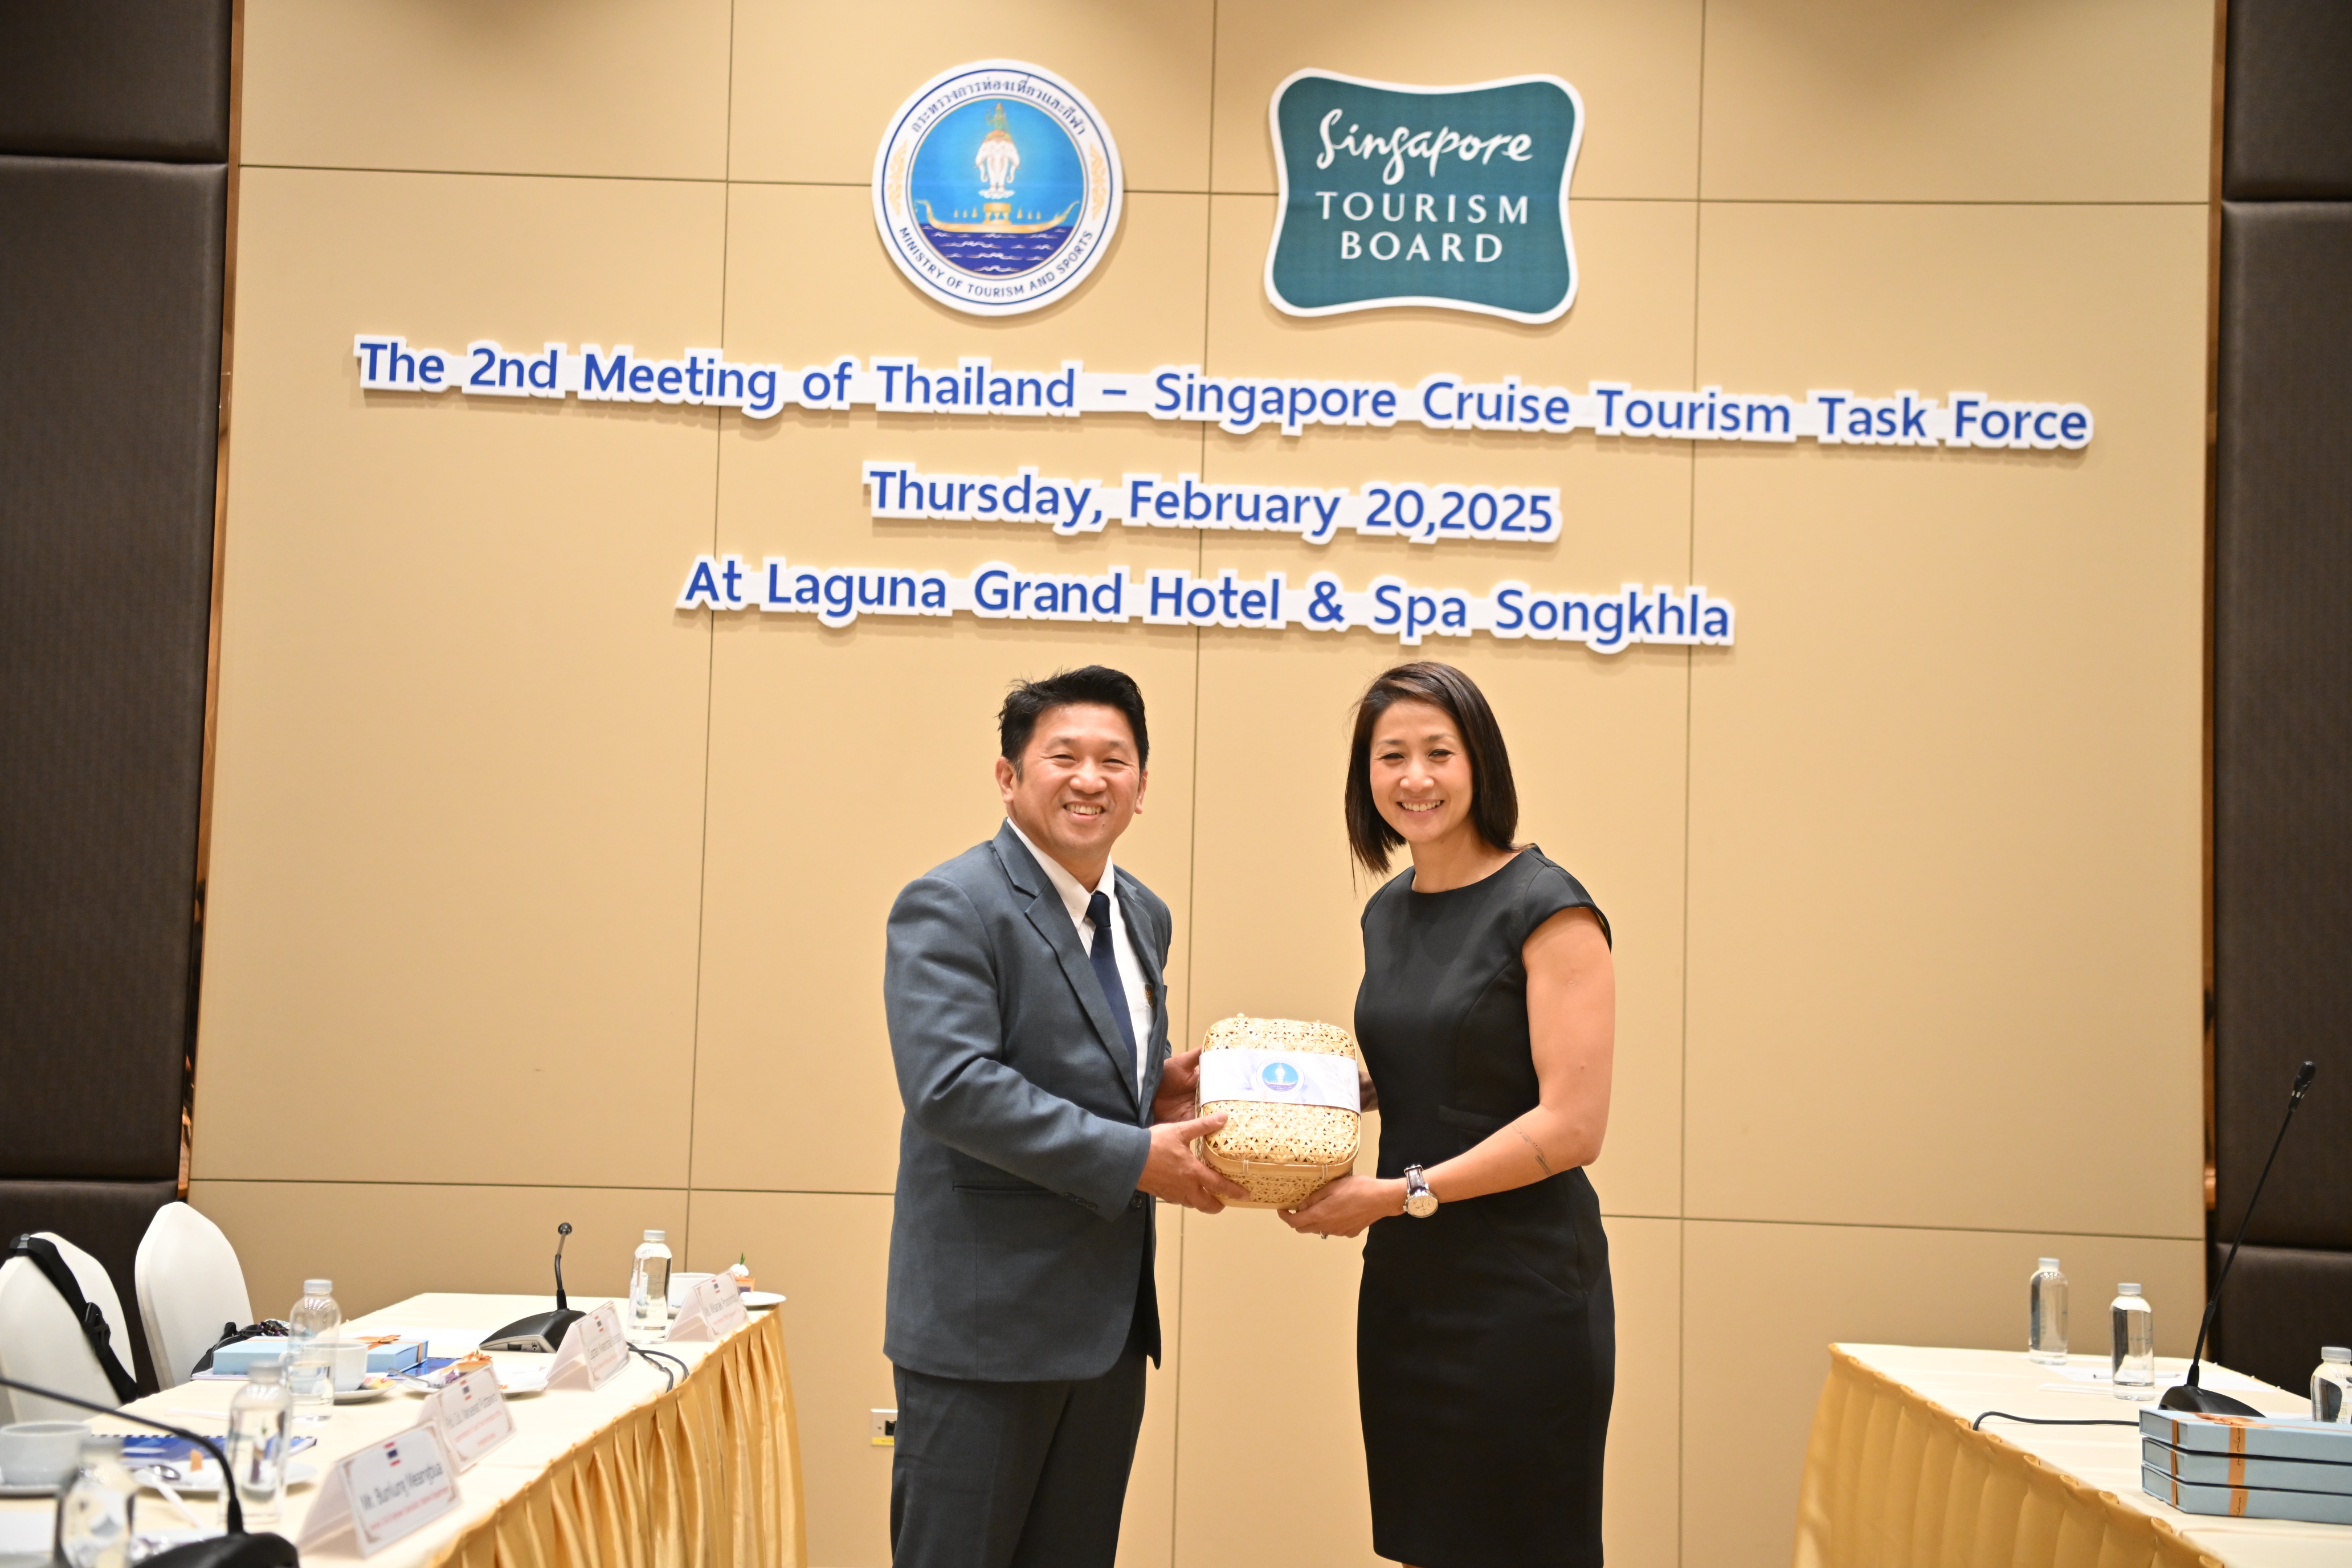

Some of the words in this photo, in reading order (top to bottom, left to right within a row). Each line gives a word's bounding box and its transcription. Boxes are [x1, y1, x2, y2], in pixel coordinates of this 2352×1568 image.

[1316, 108, 1533, 186] Singapore
[1315, 191, 1529, 224] TOURISM
[899, 226, 947, 278] MINISTRY
[946, 276, 964, 289] OF
[967, 284, 1024, 297] TOURISM
[1029, 271, 1055, 291] AND
[1057, 230, 1093, 275] SPORTS
[1340, 230, 1504, 263] BOARD
[360, 341, 446, 385] The
[469, 347, 559, 390] 2nd
[583, 353, 777, 412] Meeting
[802, 361, 854, 402] of
[876, 363, 1076, 408] Thailand
[1154, 372, 1397, 427] Singapore
[1423, 381, 1571, 426] Cruise
[1596, 389, 1791, 434] Tourism
[1818, 396, 1927, 438] Task
[1955, 399, 2088, 441] Force
[869, 468, 1103, 529] Thursday,
[1130, 479, 1342, 537] February
[1366, 488, 1553, 537] 20,2025
[684, 560, 743, 603] At
[768, 563, 947, 619] Laguna
[974, 569, 1123, 615] Grand
[1150, 575, 1280, 621] Hotel
[1308, 580, 1346, 623] &
[1374, 583, 1467, 638] Spa
[1496, 588, 1729, 646] Songkhla
